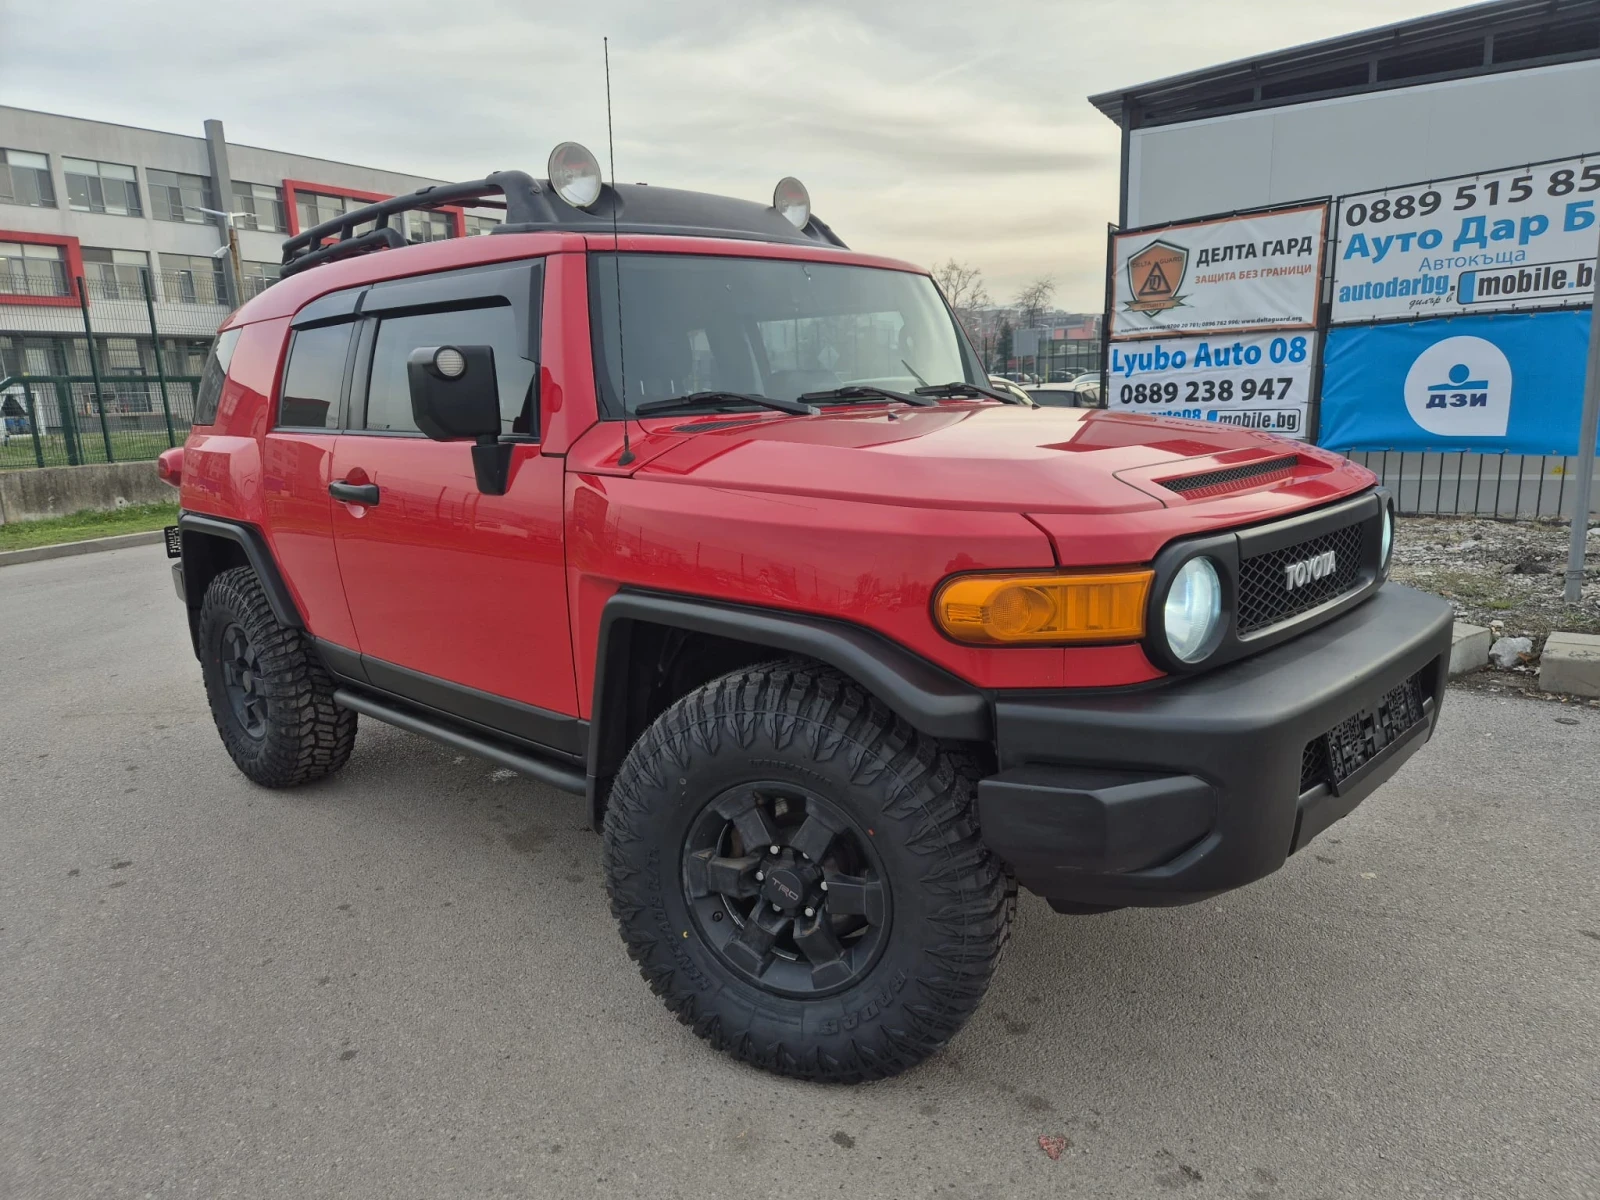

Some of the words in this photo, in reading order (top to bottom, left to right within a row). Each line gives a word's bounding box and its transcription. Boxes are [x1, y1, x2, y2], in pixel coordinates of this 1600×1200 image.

[1345, 190, 1442, 227] 0889
[1453, 175, 1533, 211] 515
[1547, 164, 1600, 197] 85
[1196, 243, 1257, 268] ДЕЛТА
[1262, 236, 1312, 257] ГАРД
[1343, 228, 1443, 264] Ауто
[1452, 214, 1549, 252] Дар
[1131, 260, 1152, 269] DELTA
[1159, 256, 1183, 265] GUARD
[1195, 271, 1236, 284] ЗАЩИТА
[1238, 269, 1258, 280] БЕЗ
[1260, 264, 1312, 277] ГРАНИЦИ
[1418, 249, 1526, 272] Автокъща
[1478, 263, 1595, 296] mobile.b
[1112, 344, 1187, 378] Lyubo
[1194, 341, 1262, 368] Auto
[1269, 336, 1307, 364] 08
[1120, 382, 1179, 405] 0889
[1185, 379, 1234, 403] 238
[1241, 377, 1294, 401] 947
[1425, 392, 1488, 409] ДЗИ
[1218, 411, 1297, 431] mobile.bg
[1284, 550, 1337, 591] TOYOTA
